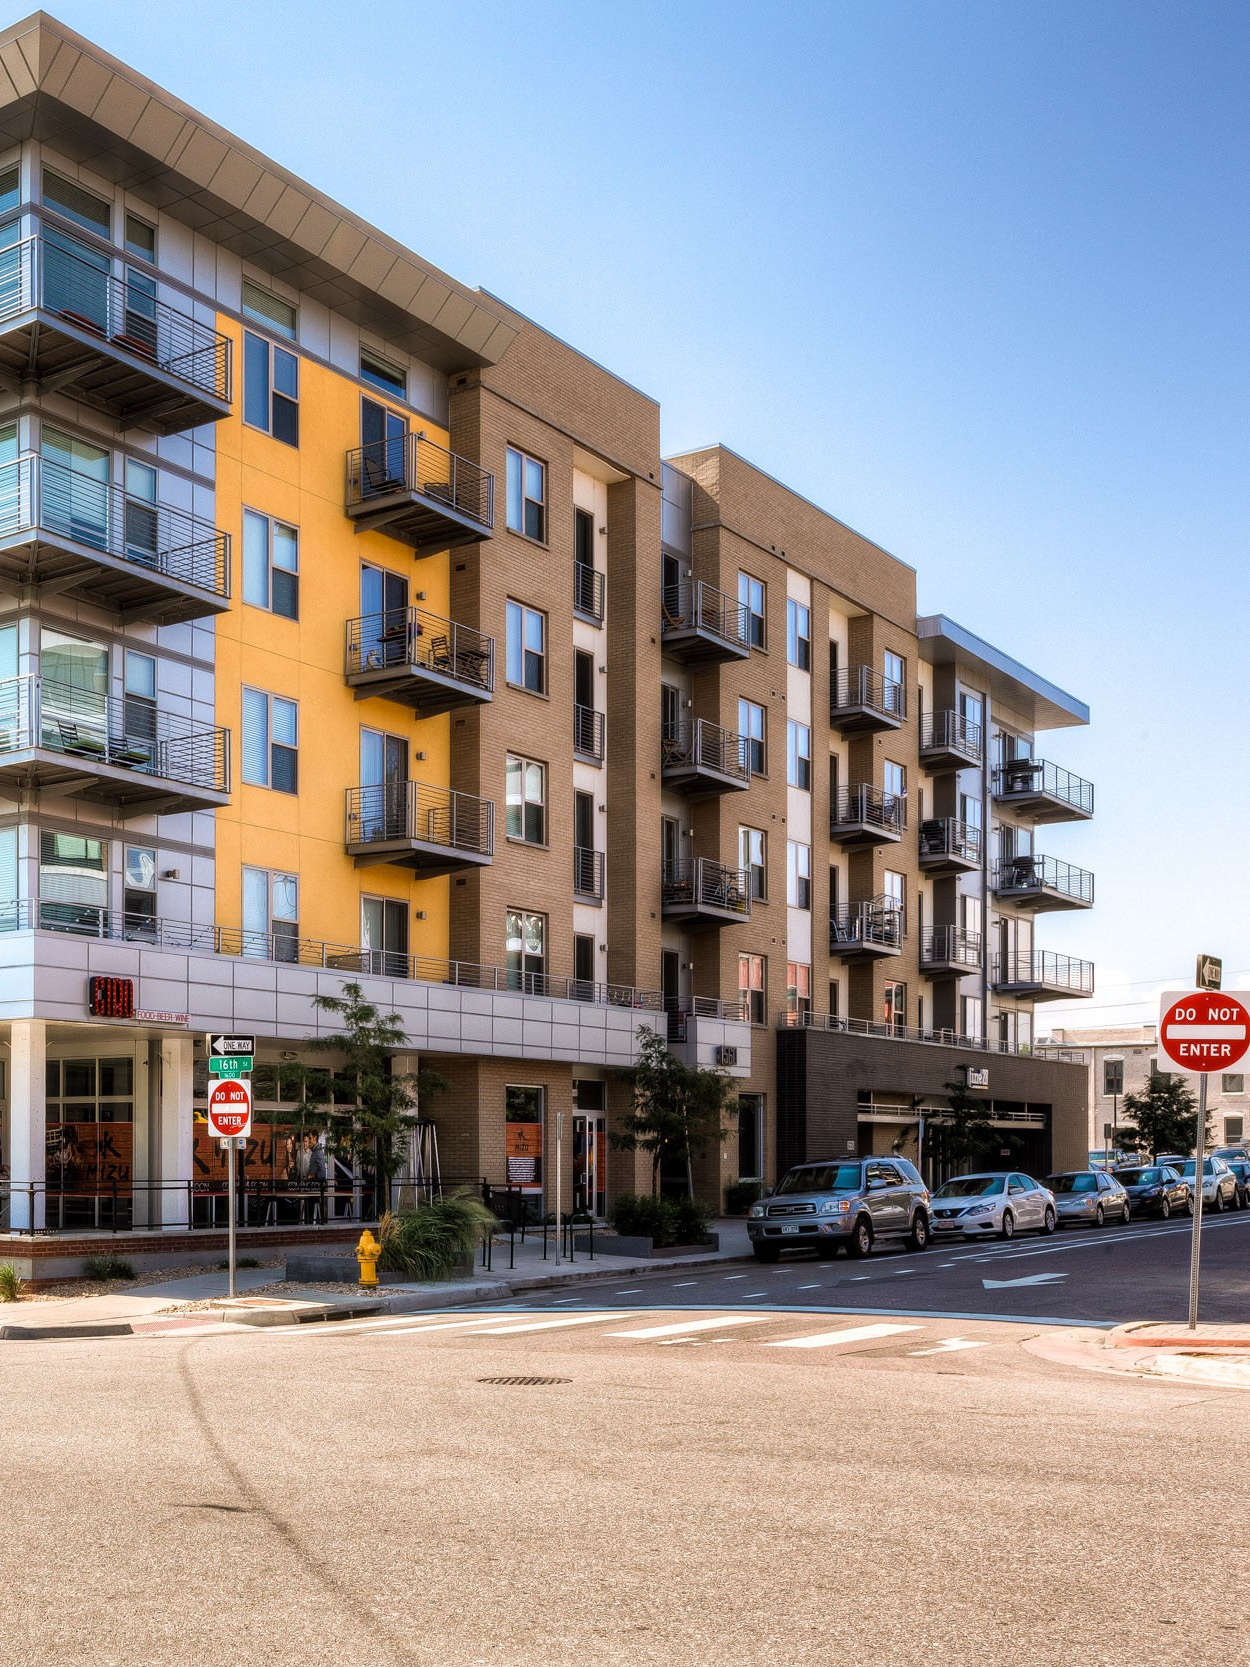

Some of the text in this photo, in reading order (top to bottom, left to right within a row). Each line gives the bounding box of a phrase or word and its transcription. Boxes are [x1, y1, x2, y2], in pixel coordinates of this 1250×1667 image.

[137, 1011, 155, 1020] FOOD
[1175, 1008, 1240, 1021] DO NOT
[224, 1041, 250, 1050] ONE WAY
[1180, 1044, 1231, 1057] ENTER
[219, 1060, 238, 1070] 16th
[215, 1092, 244, 1101] DO NOT
[218, 1116, 242, 1125] ENTER
[515, 1144, 529, 1152] MIZU
[86, 1165, 129, 1180] MIZU
